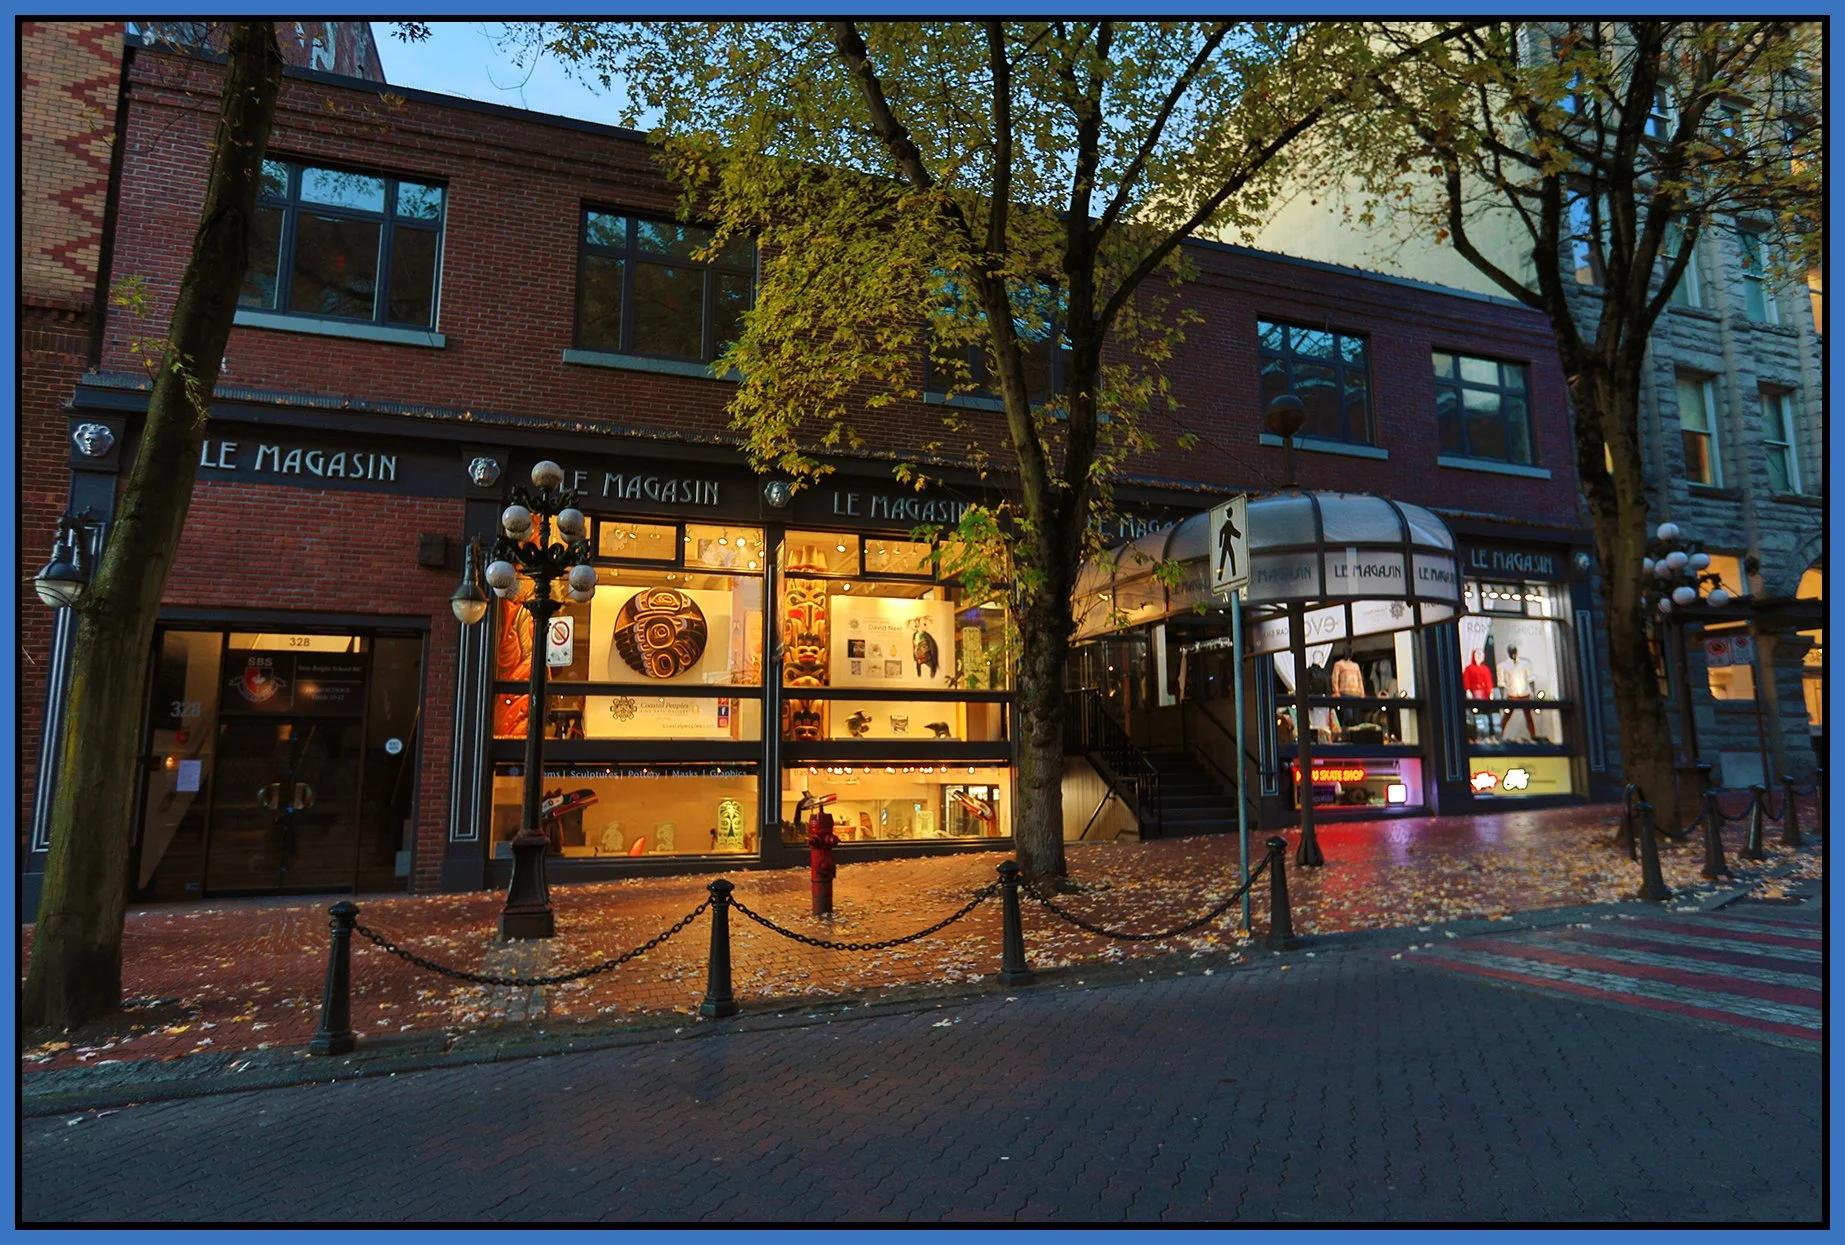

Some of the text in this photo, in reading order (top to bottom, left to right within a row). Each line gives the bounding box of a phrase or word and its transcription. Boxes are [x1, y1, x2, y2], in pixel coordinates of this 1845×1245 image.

[200, 439, 398, 481] LE MAGASIN
[602, 471, 719, 506] MAGASIN
[833, 491, 861, 517] LE
[1471, 547, 1554, 574] LE MAGASIN
[1334, 564, 1402, 578] LE MAGASIN
[289, 637, 310, 647] 328
[247, 657, 273, 666] SBS
[169, 700, 201, 718] 328
[543, 770, 747, 780] ems Sculptures Pottery Masks Graphics
[1342, 769, 1365, 781] SHOP
